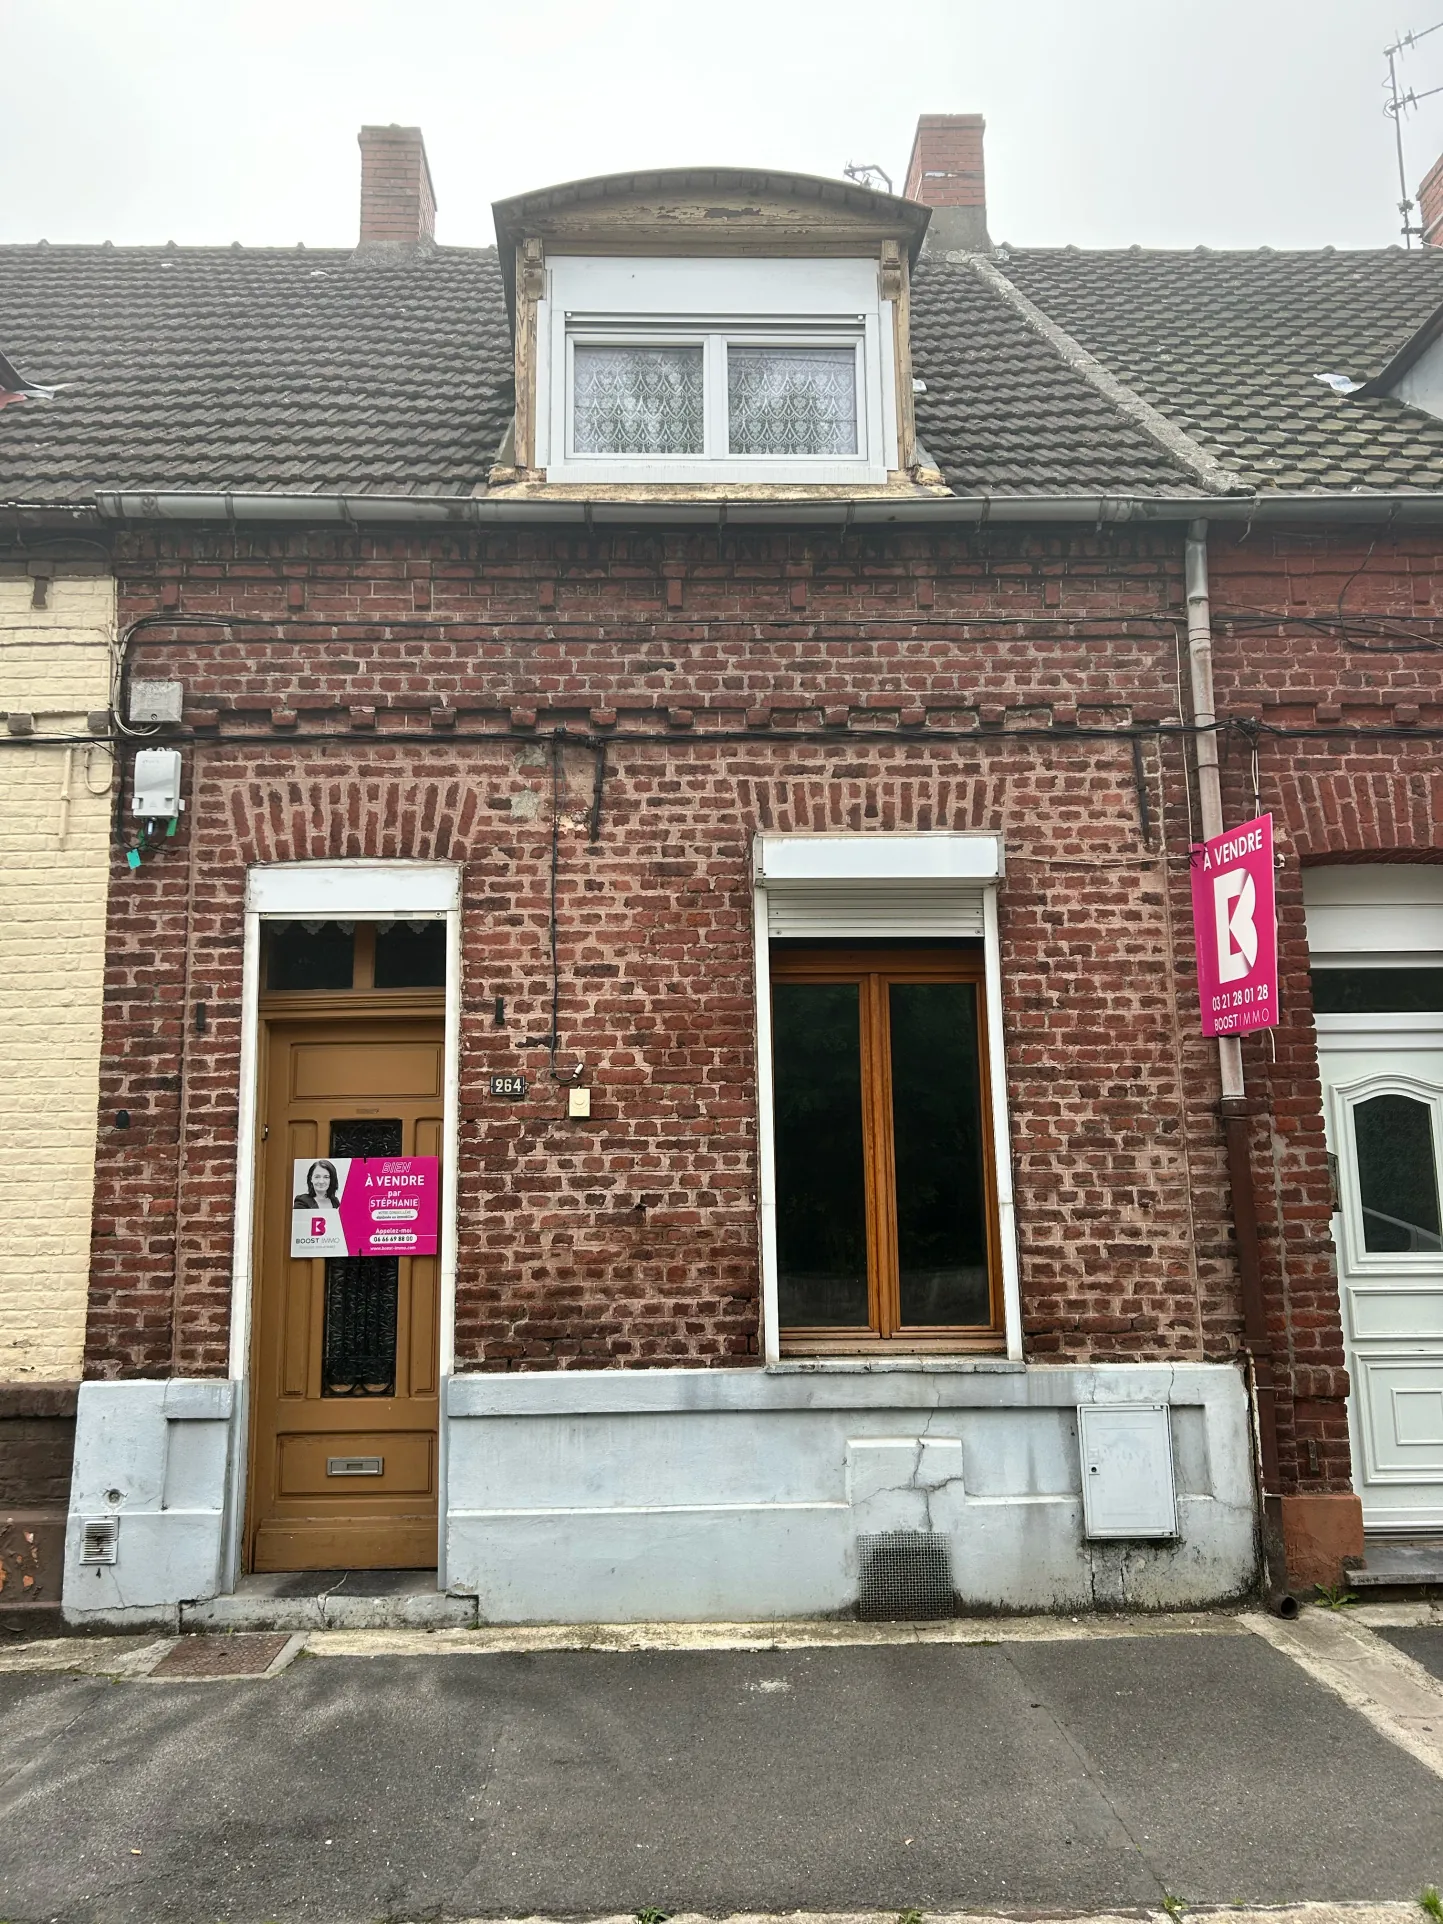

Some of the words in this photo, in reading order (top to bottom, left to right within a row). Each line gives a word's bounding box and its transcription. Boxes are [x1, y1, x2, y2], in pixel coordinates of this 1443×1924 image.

[1203, 847, 1213, 871] À
[1214, 828, 1263, 864] VENDRE
[1212, 995, 1221, 1011] 03
[1221, 993, 1230, 1009] 21
[1232, 990, 1243, 1006] 28
[1244, 987, 1254, 1004] 01
[1257, 984, 1269, 1001] 28
[495, 1078, 522, 1092] 264
[381, 1161, 412, 1174] BIEN
[364, 1173, 374, 1187] À
[376, 1174, 425, 1186] VENDRE
[387, 1190, 401, 1199] par
[370, 1196, 419, 1208] STÉPHANIE
[295, 1237, 320, 1245] BOOST
